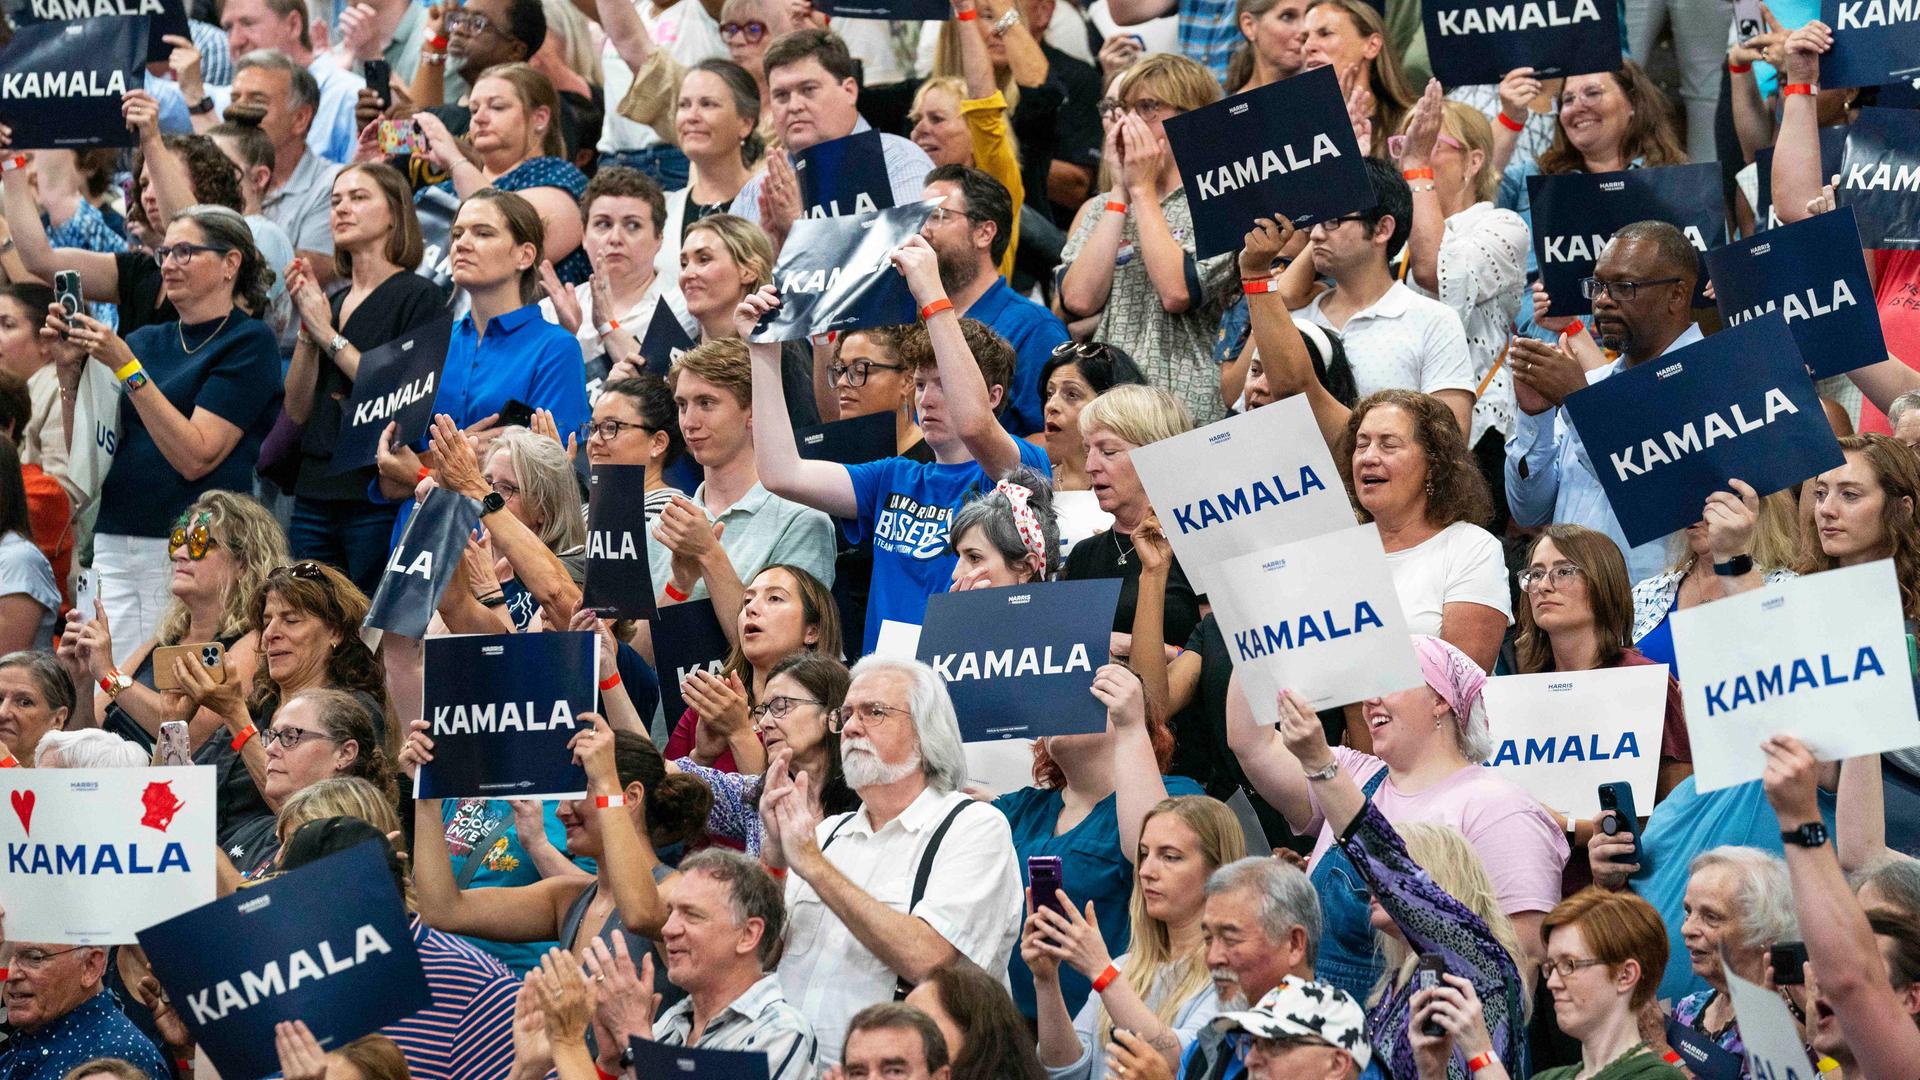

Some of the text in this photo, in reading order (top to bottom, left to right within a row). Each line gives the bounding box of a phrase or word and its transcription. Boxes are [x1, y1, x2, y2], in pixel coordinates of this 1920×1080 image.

[33, 0, 164, 21] KAMALA
[1437, 0, 1601, 36] KAMALA
[2, 70, 126, 99] KAMALA
[1196, 132, 1341, 200] KAMALA
[1656, 362, 1682, 377] HARRIS
[352, 371, 434, 426] KAMALA
[1208, 431, 1231, 443] HARRIS
[1609, 387, 1799, 482] KAMALA
[1172, 465, 1326, 534] KAMALA
[386, 545, 432, 580] LA
[1234, 600, 1384, 662] KAMALA
[932, 643, 1091, 682] KAMALA
[1548, 682, 1573, 690] HARRIS
[1704, 646, 1885, 717] KAMALA
[433, 700, 575, 736] KAMALA
[1482, 731, 1640, 767] AMALA
[8, 842, 191, 875] KAMALA
[186, 923, 392, 1025] KAMALA
[1680, 1040, 1709, 1061] HARRIS
